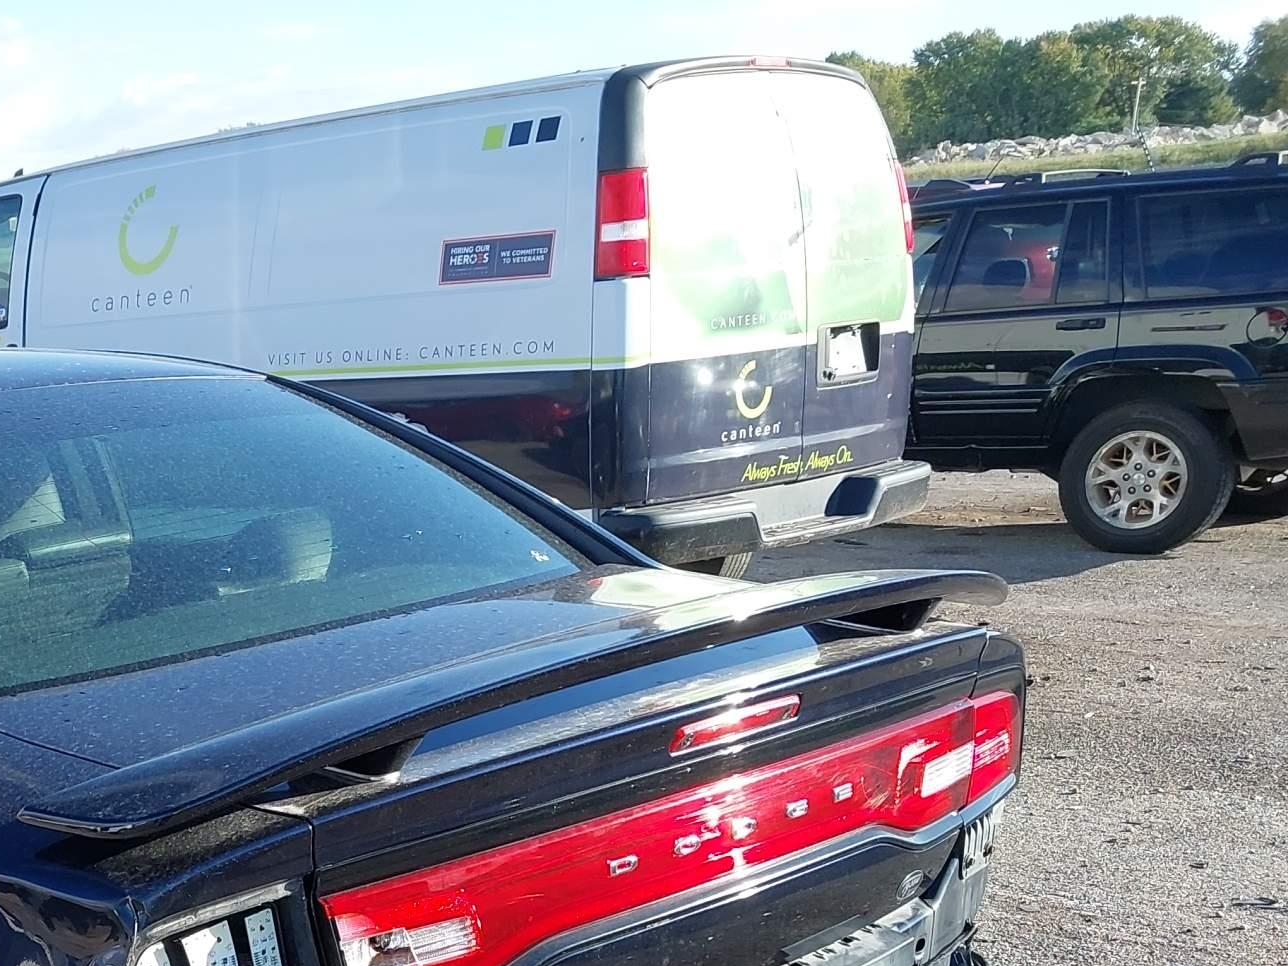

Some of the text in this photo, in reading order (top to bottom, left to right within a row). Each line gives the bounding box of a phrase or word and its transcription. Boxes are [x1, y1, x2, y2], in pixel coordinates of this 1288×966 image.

[451, 244, 491, 255] HIRING OUR
[511, 247, 549, 256] COMMITTED
[512, 255, 545, 263] VETERANS
[91, 287, 191, 313] canteen
[268, 340, 555, 366] VISIT US ONLINE: CANTEEN.COM
[721, 421, 781, 441] canteen
[740, 462, 777, 482] Always
[805, 451, 835, 472] Always
[607, 782, 854, 877] DODGE
